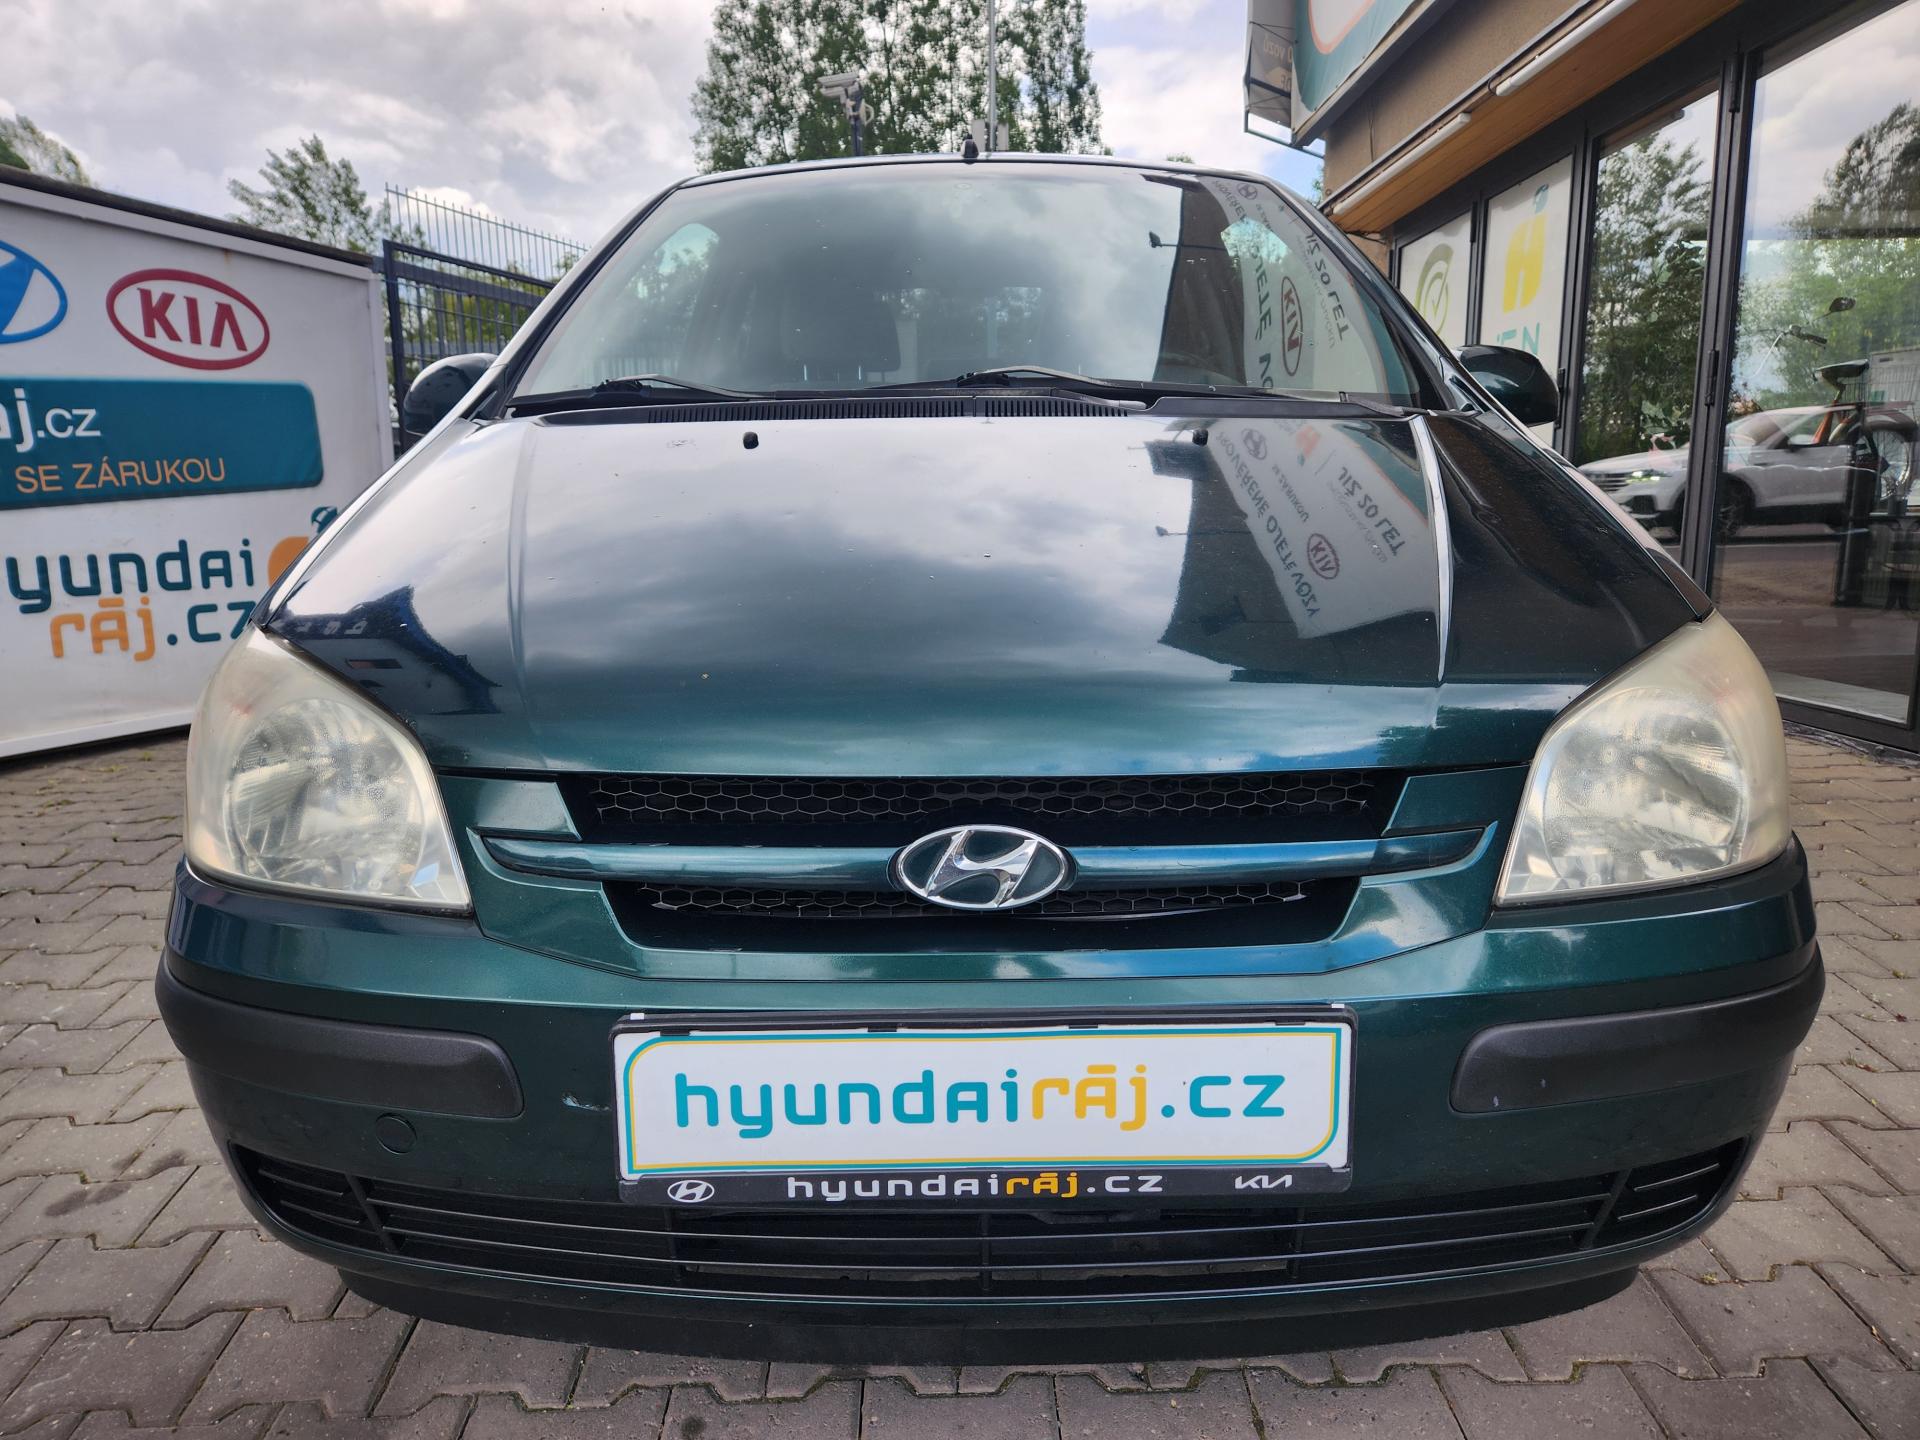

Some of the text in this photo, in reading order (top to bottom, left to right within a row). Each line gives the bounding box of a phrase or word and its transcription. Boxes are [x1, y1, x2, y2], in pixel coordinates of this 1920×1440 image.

[136, 286, 248, 352] KIA
[15, 456, 226, 494] SE ZÁRUKOU
